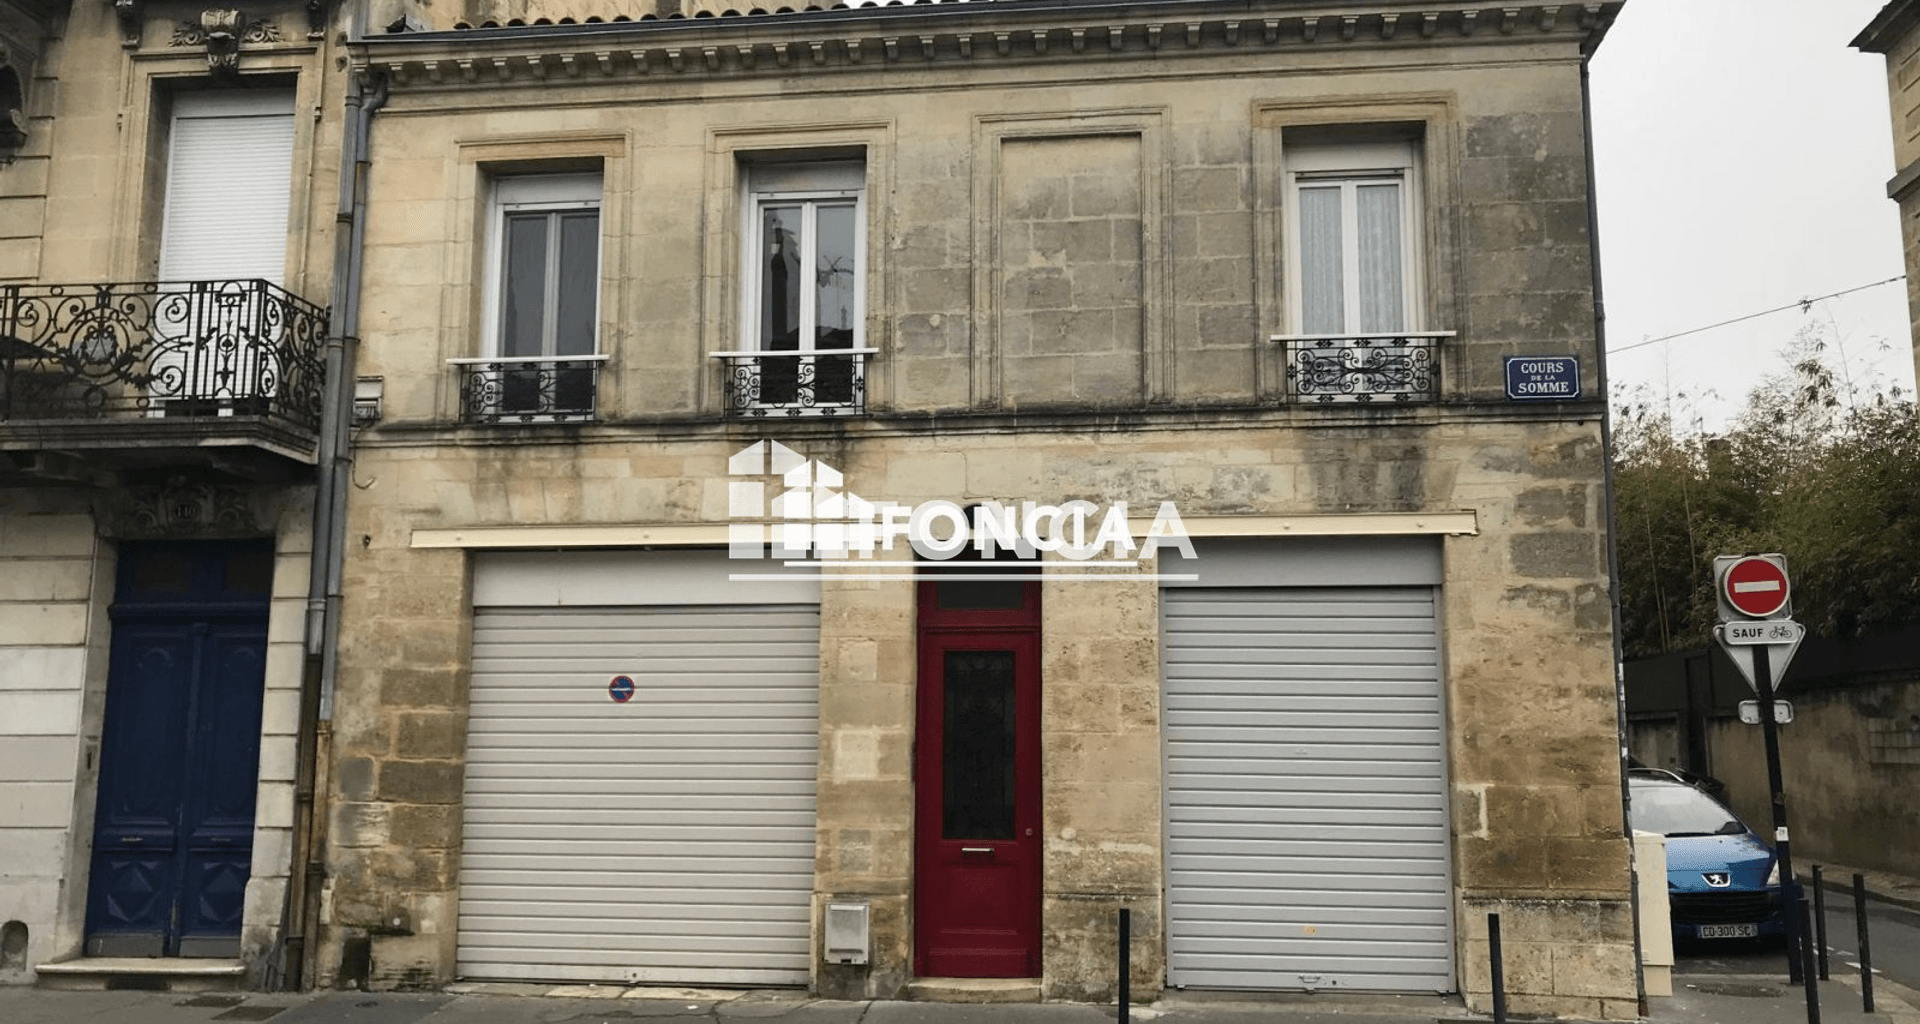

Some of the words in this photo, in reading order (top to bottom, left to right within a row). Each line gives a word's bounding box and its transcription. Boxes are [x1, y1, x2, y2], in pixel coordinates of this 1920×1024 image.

[1521, 362, 1564, 374] COURS
[1518, 381, 1569, 394] SOMME
[1732, 628, 1764, 638] SAUF
